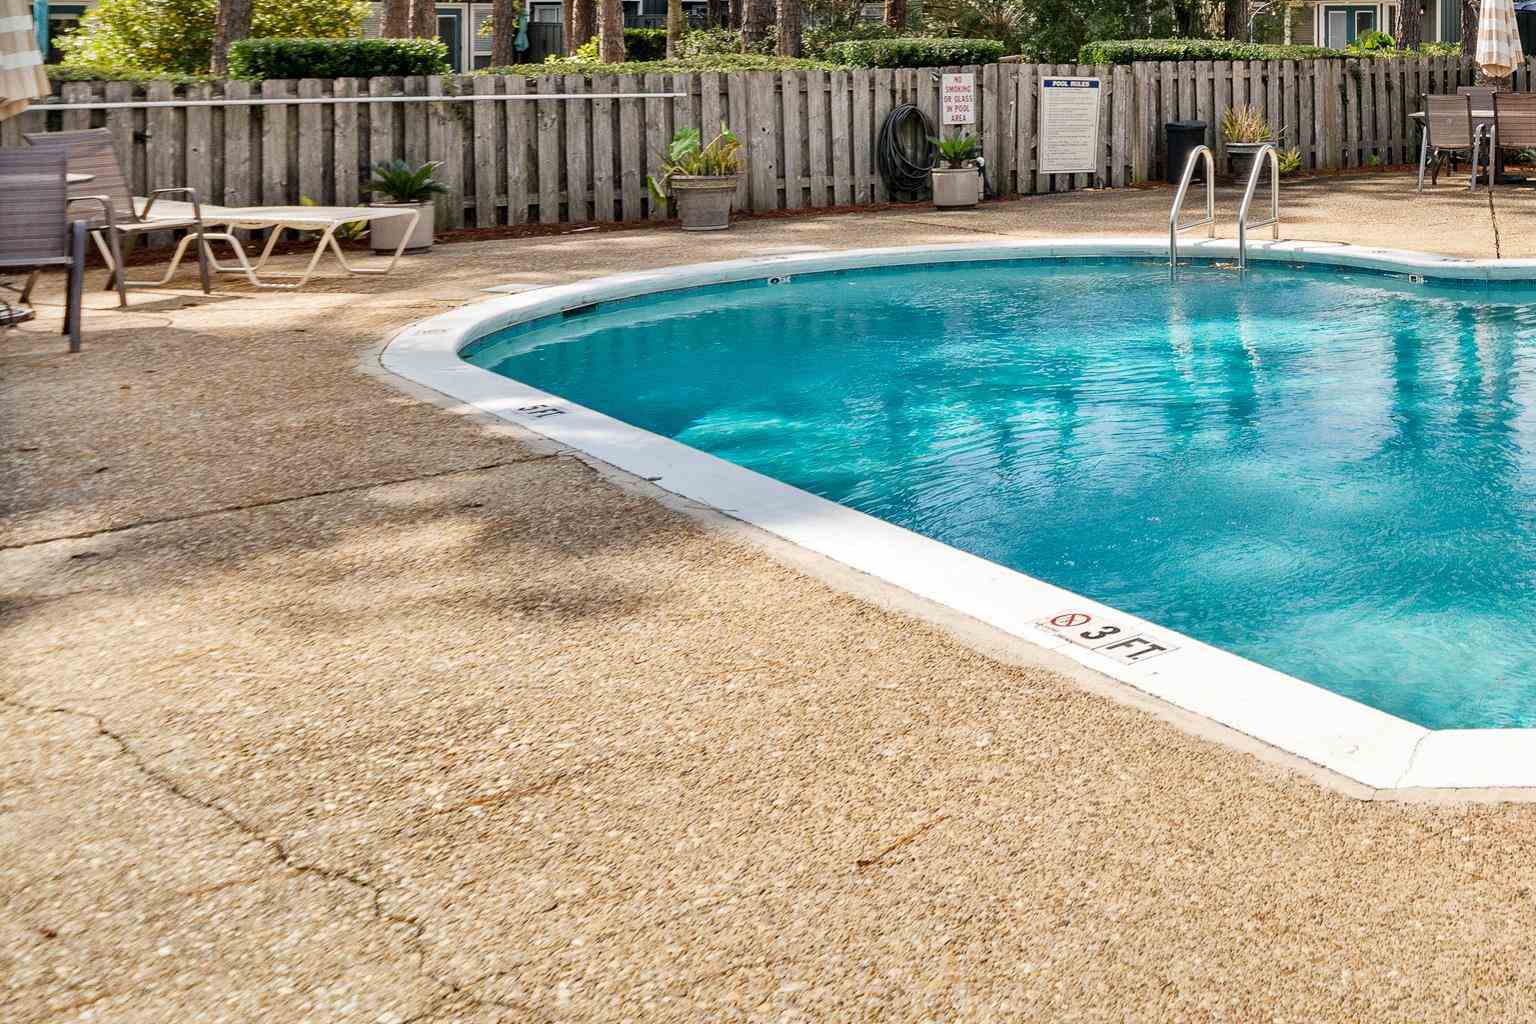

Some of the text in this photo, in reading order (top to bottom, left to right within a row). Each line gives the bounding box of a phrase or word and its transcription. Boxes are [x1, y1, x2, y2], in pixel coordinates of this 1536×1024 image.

[954, 95, 972, 103] GLASS
[955, 104, 969, 113] POOL
[1080, 626, 1121, 640] 3
